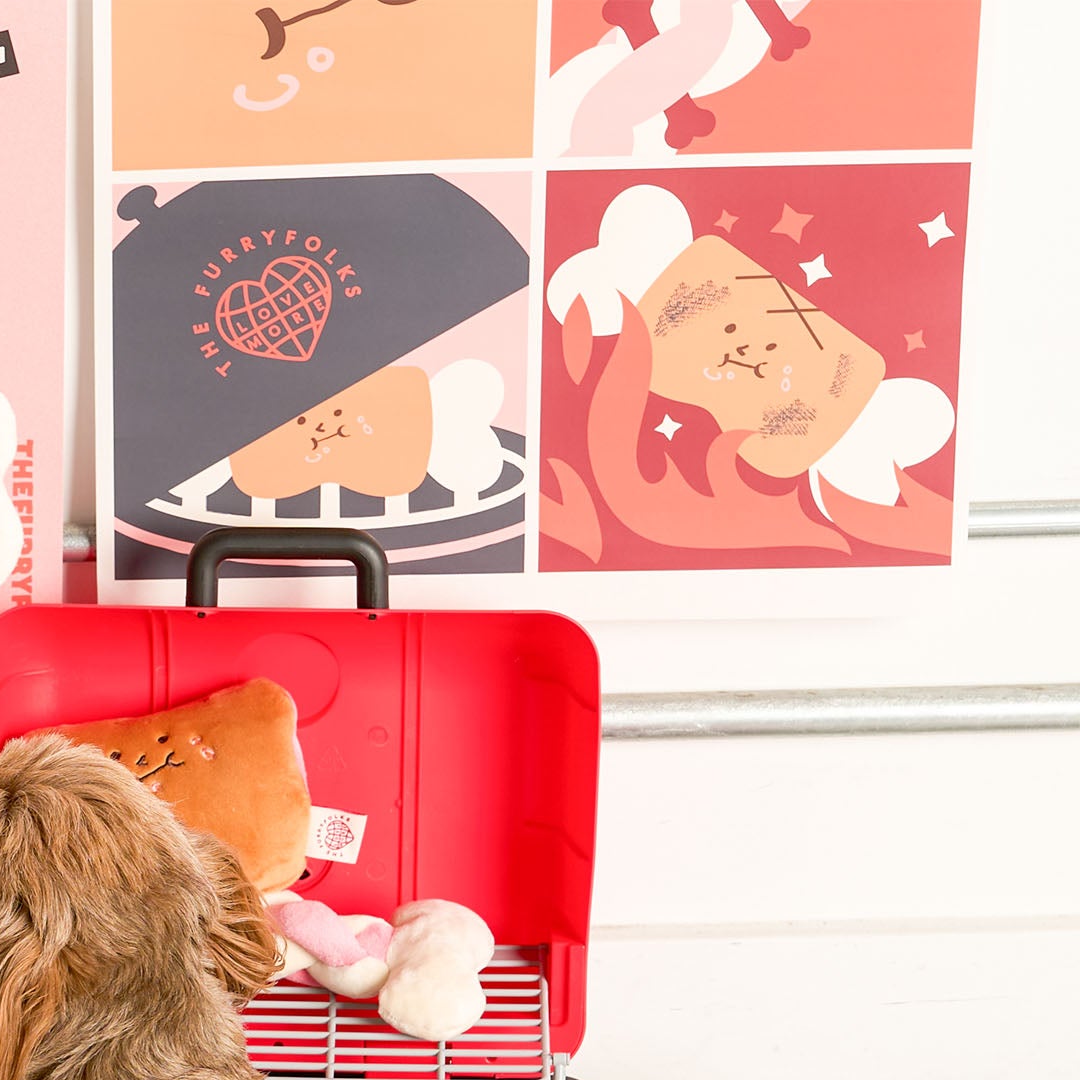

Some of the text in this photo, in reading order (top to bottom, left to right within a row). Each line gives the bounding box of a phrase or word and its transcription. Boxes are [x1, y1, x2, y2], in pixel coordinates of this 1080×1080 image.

[192, 229, 362, 378] THE FURRYFOLKS
[236, 280, 316, 334] LOVE
[246, 298, 326, 351] MORE
